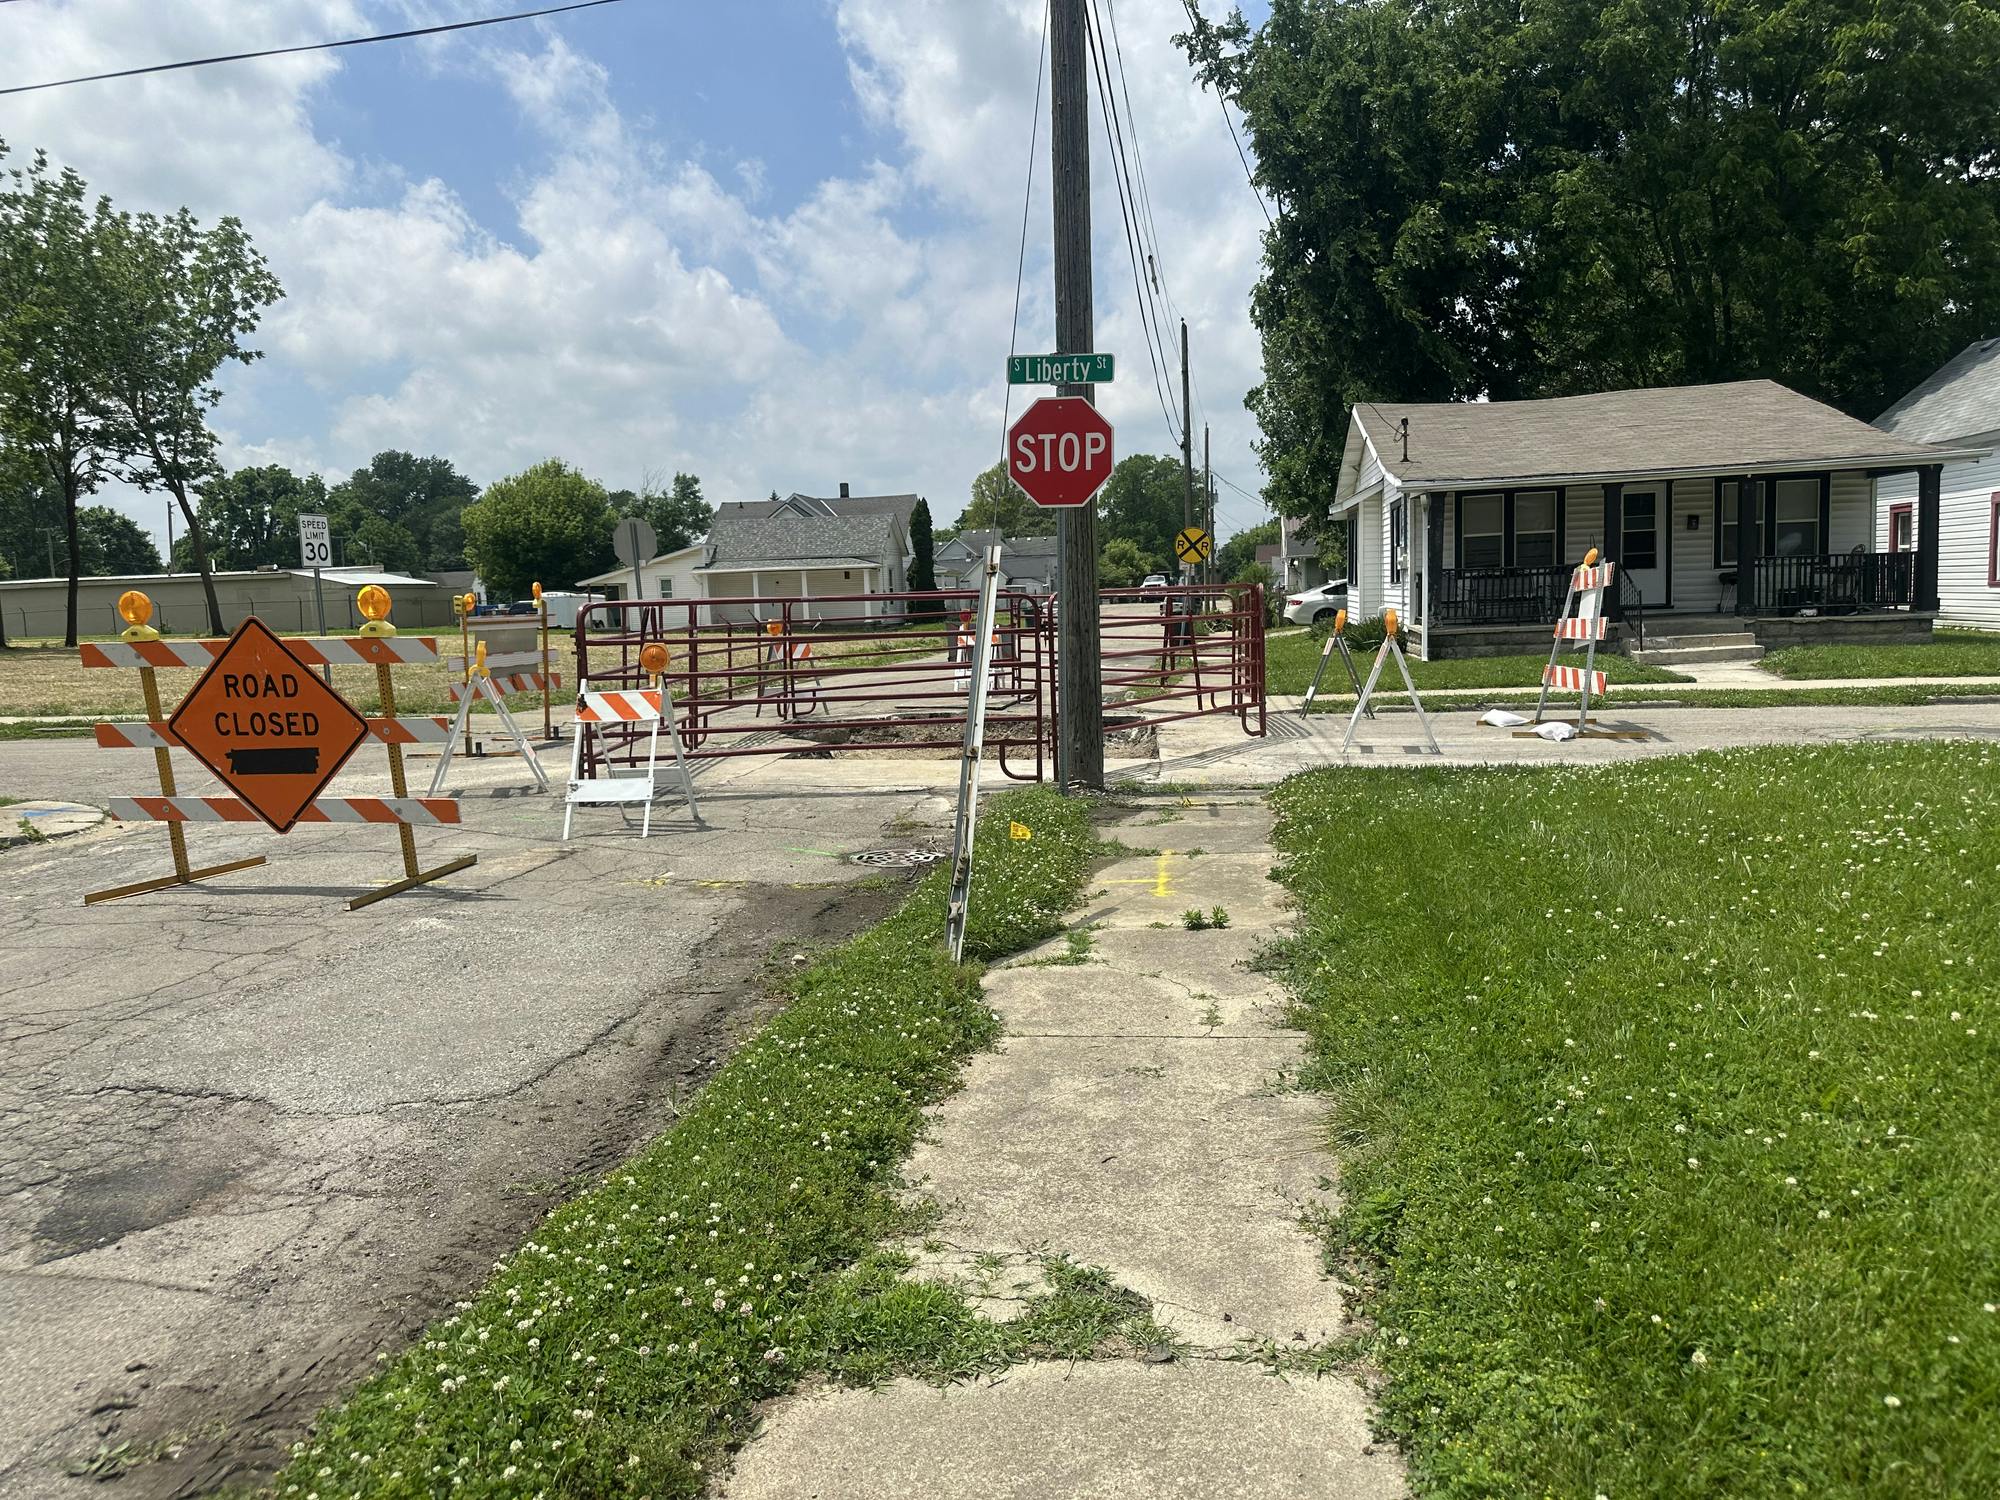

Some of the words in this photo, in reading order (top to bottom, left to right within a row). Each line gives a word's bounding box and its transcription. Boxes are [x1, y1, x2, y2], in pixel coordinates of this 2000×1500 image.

[1014, 358, 1021, 372] S
[1025, 357, 1091, 382] Liberty
[1096, 356, 1107, 369] St
[1015, 432, 1106, 473] STOP
[301, 520, 327, 530] SPEED
[305, 531, 325, 540] LIMIT
[305, 542, 329, 561] 30
[1177, 540, 1185, 550] R
[1201, 541, 1209, 551] R
[223, 673, 299, 698] ROAD
[214, 712, 320, 737] CLOSED
